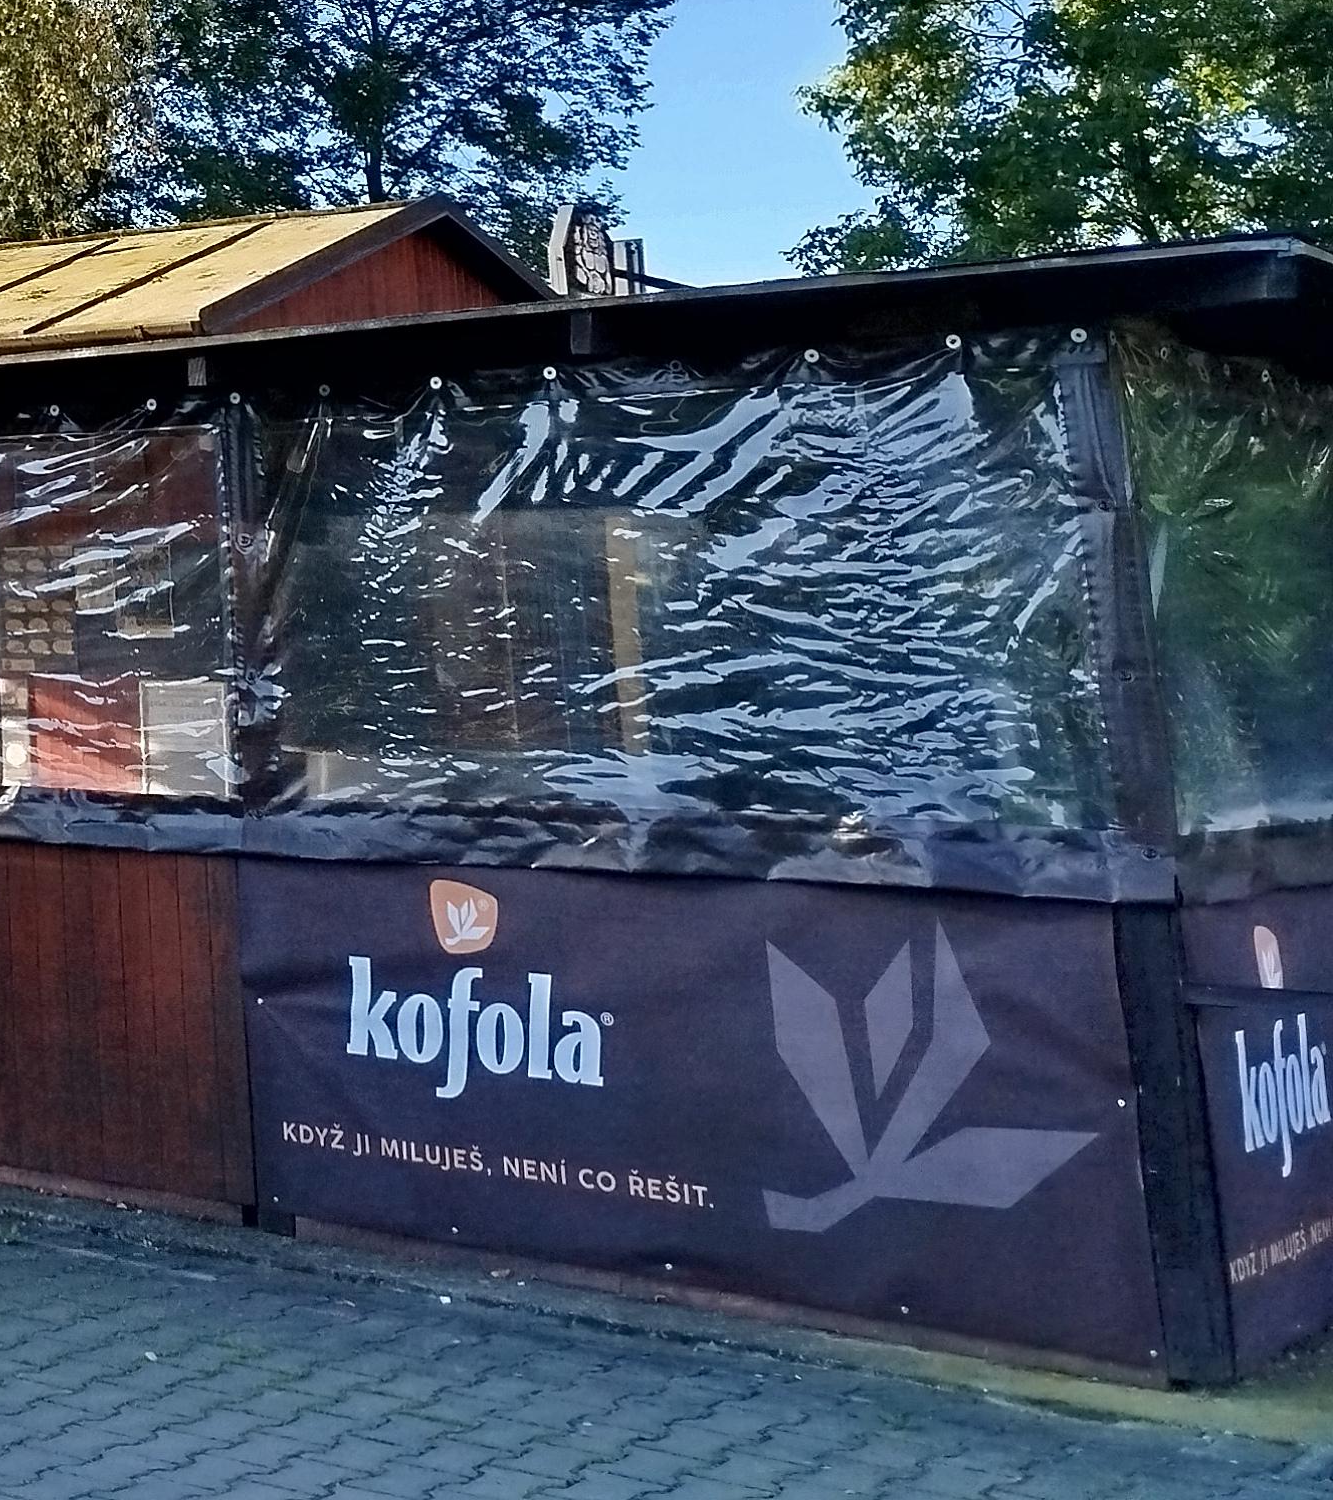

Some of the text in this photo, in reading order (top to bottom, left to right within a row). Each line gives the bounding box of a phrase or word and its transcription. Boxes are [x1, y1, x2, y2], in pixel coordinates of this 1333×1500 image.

[282, 1121, 715, 1210] KDYŽ JI MILUJEŠ, NENÍ CO ŘEŠIT.
